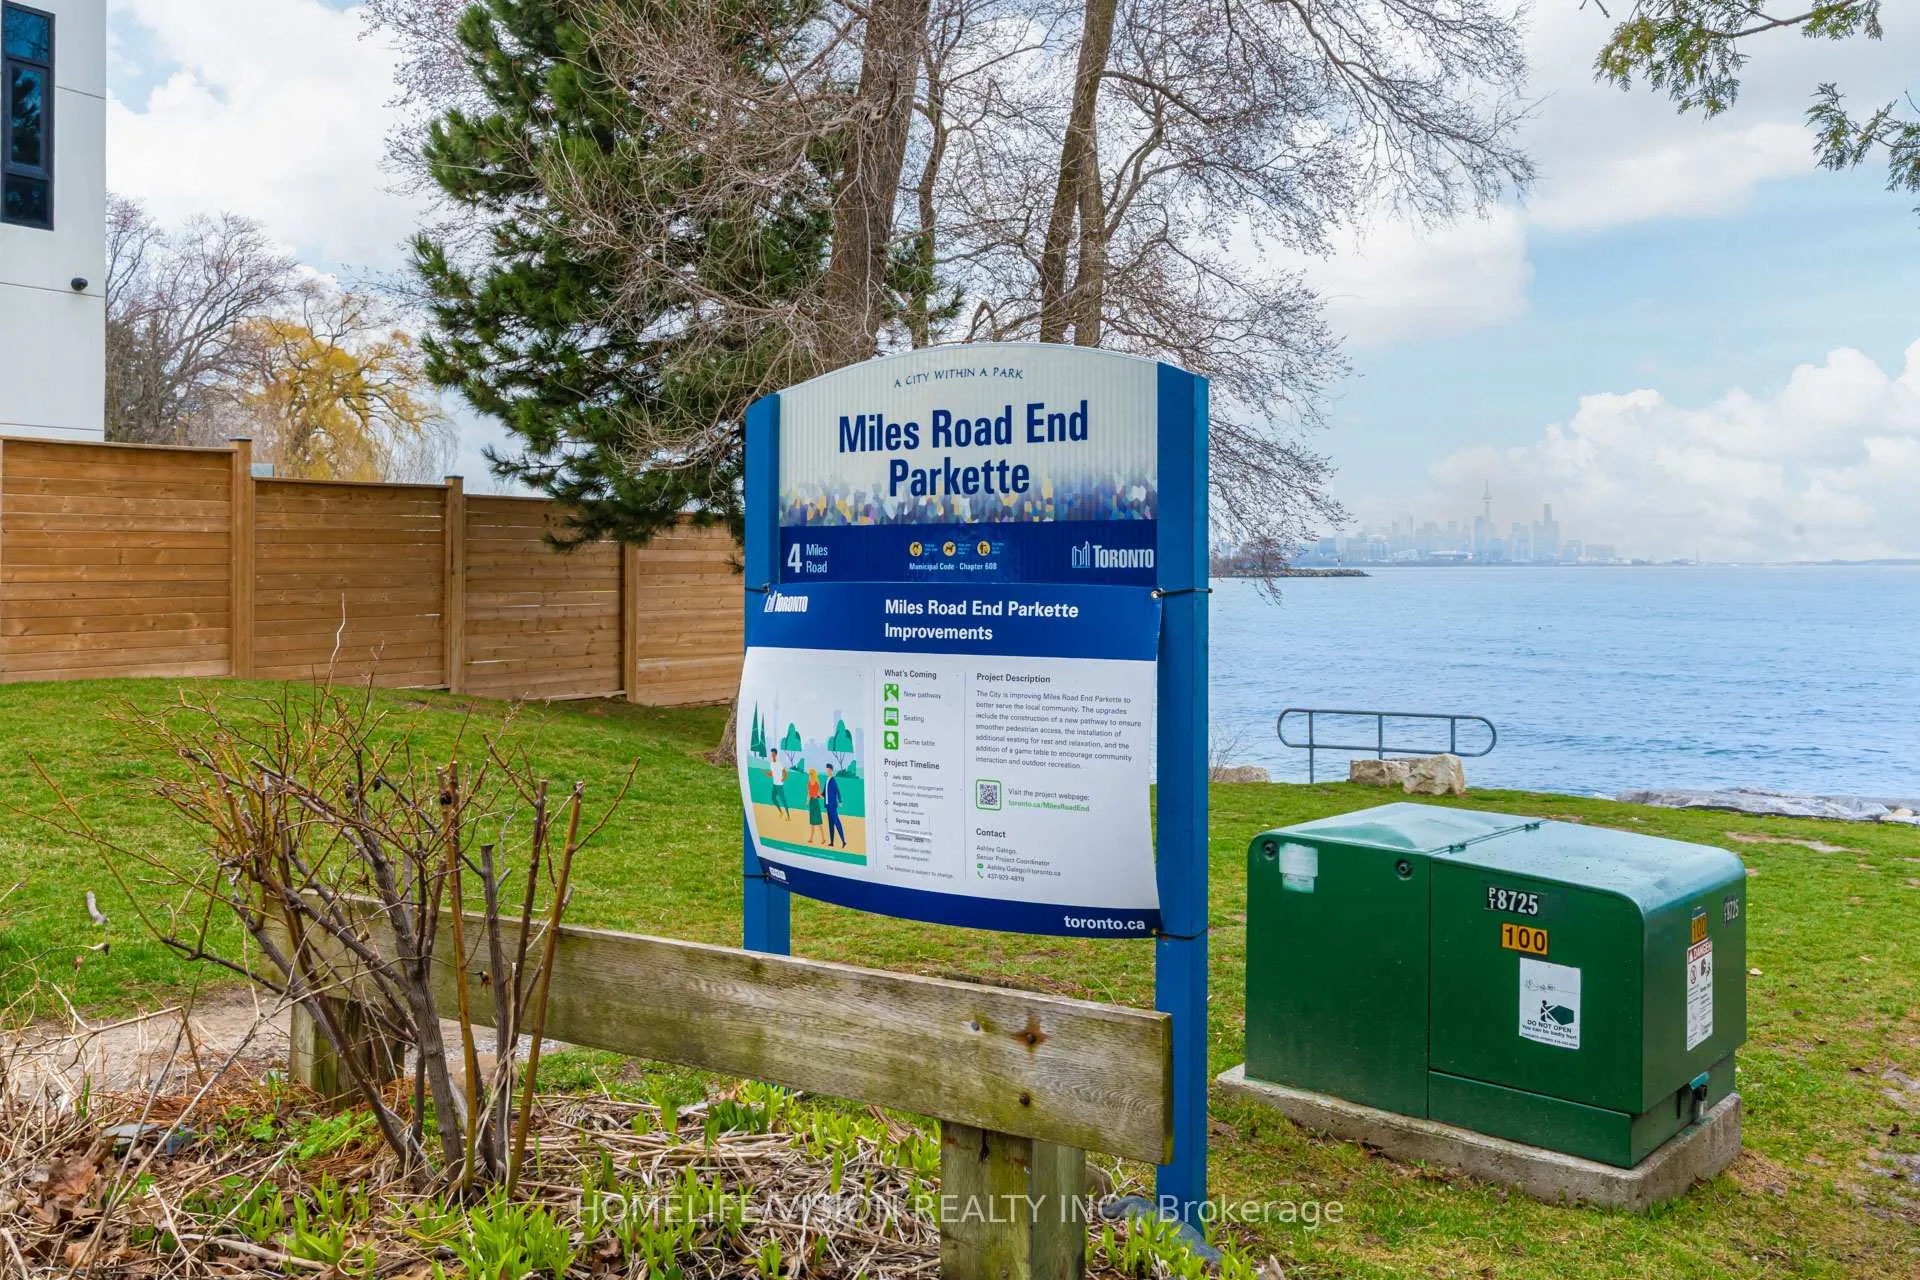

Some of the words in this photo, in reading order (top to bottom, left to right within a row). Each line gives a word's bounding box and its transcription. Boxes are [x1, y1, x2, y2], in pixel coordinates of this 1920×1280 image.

[894, 378, 901, 388] A
[906, 372, 929, 385] CITY
[934, 368, 975, 380] WITHIN
[980, 368, 987, 376] A
[993, 367, 1023, 379] PARK
[839, 414, 920, 453] Miles
[932, 405, 1012, 448] Road
[1026, 400, 1088, 444] End
[890, 456, 1030, 497] Parkette
[806, 544, 828, 558] Miles
[788, 544, 802, 574] 4
[1093, 545, 1154, 569] TORONTO
[806, 560, 828, 574] Road
[909, 562, 938, 571] Municipal
[940, 562, 955, 570] Code
[960, 562, 983, 571] Chapter
[774, 596, 808, 612] TORONTO
[885, 599, 924, 614] Miles
[928, 599, 966, 615] Road
[972, 600, 1002, 616] End
[1008, 600, 1079, 618] Parkette
[885, 622, 993, 641] Improvements
[884, 669, 908, 677] What's
[910, 670, 937, 680] Coming
[976, 673, 1004, 682] Project
[1006, 674, 1051, 684] Description
[918, 691, 941, 699] pathway
[1010, 692, 1041, 701] improving
[1042, 704, 1080, 713] community.
[904, 715, 924, 723] Seating
[1080, 718, 1108, 726] pathway
[1059, 751, 1092, 759] encourage
[1095, 752, 1132, 762] community
[884, 758, 908, 768] Project
[910, 760, 940, 769] Timeline
[1022, 759, 1047, 767] outdoor
[1035, 791, 1056, 799] project
[1058, 793, 1090, 802] webpage:
[976, 828, 1006, 838] Contact
[976, 845, 995, 853] Ashley
[1016, 858, 1050, 866] Coordinator
[1498, 890, 1538, 915] 8725
[1064, 915, 1146, 930] toronto.ca
[1506, 926, 1546, 952] 100
[1551, 1029, 1565, 1038] badly
[1554, 1025, 1572, 1033] OPEN
